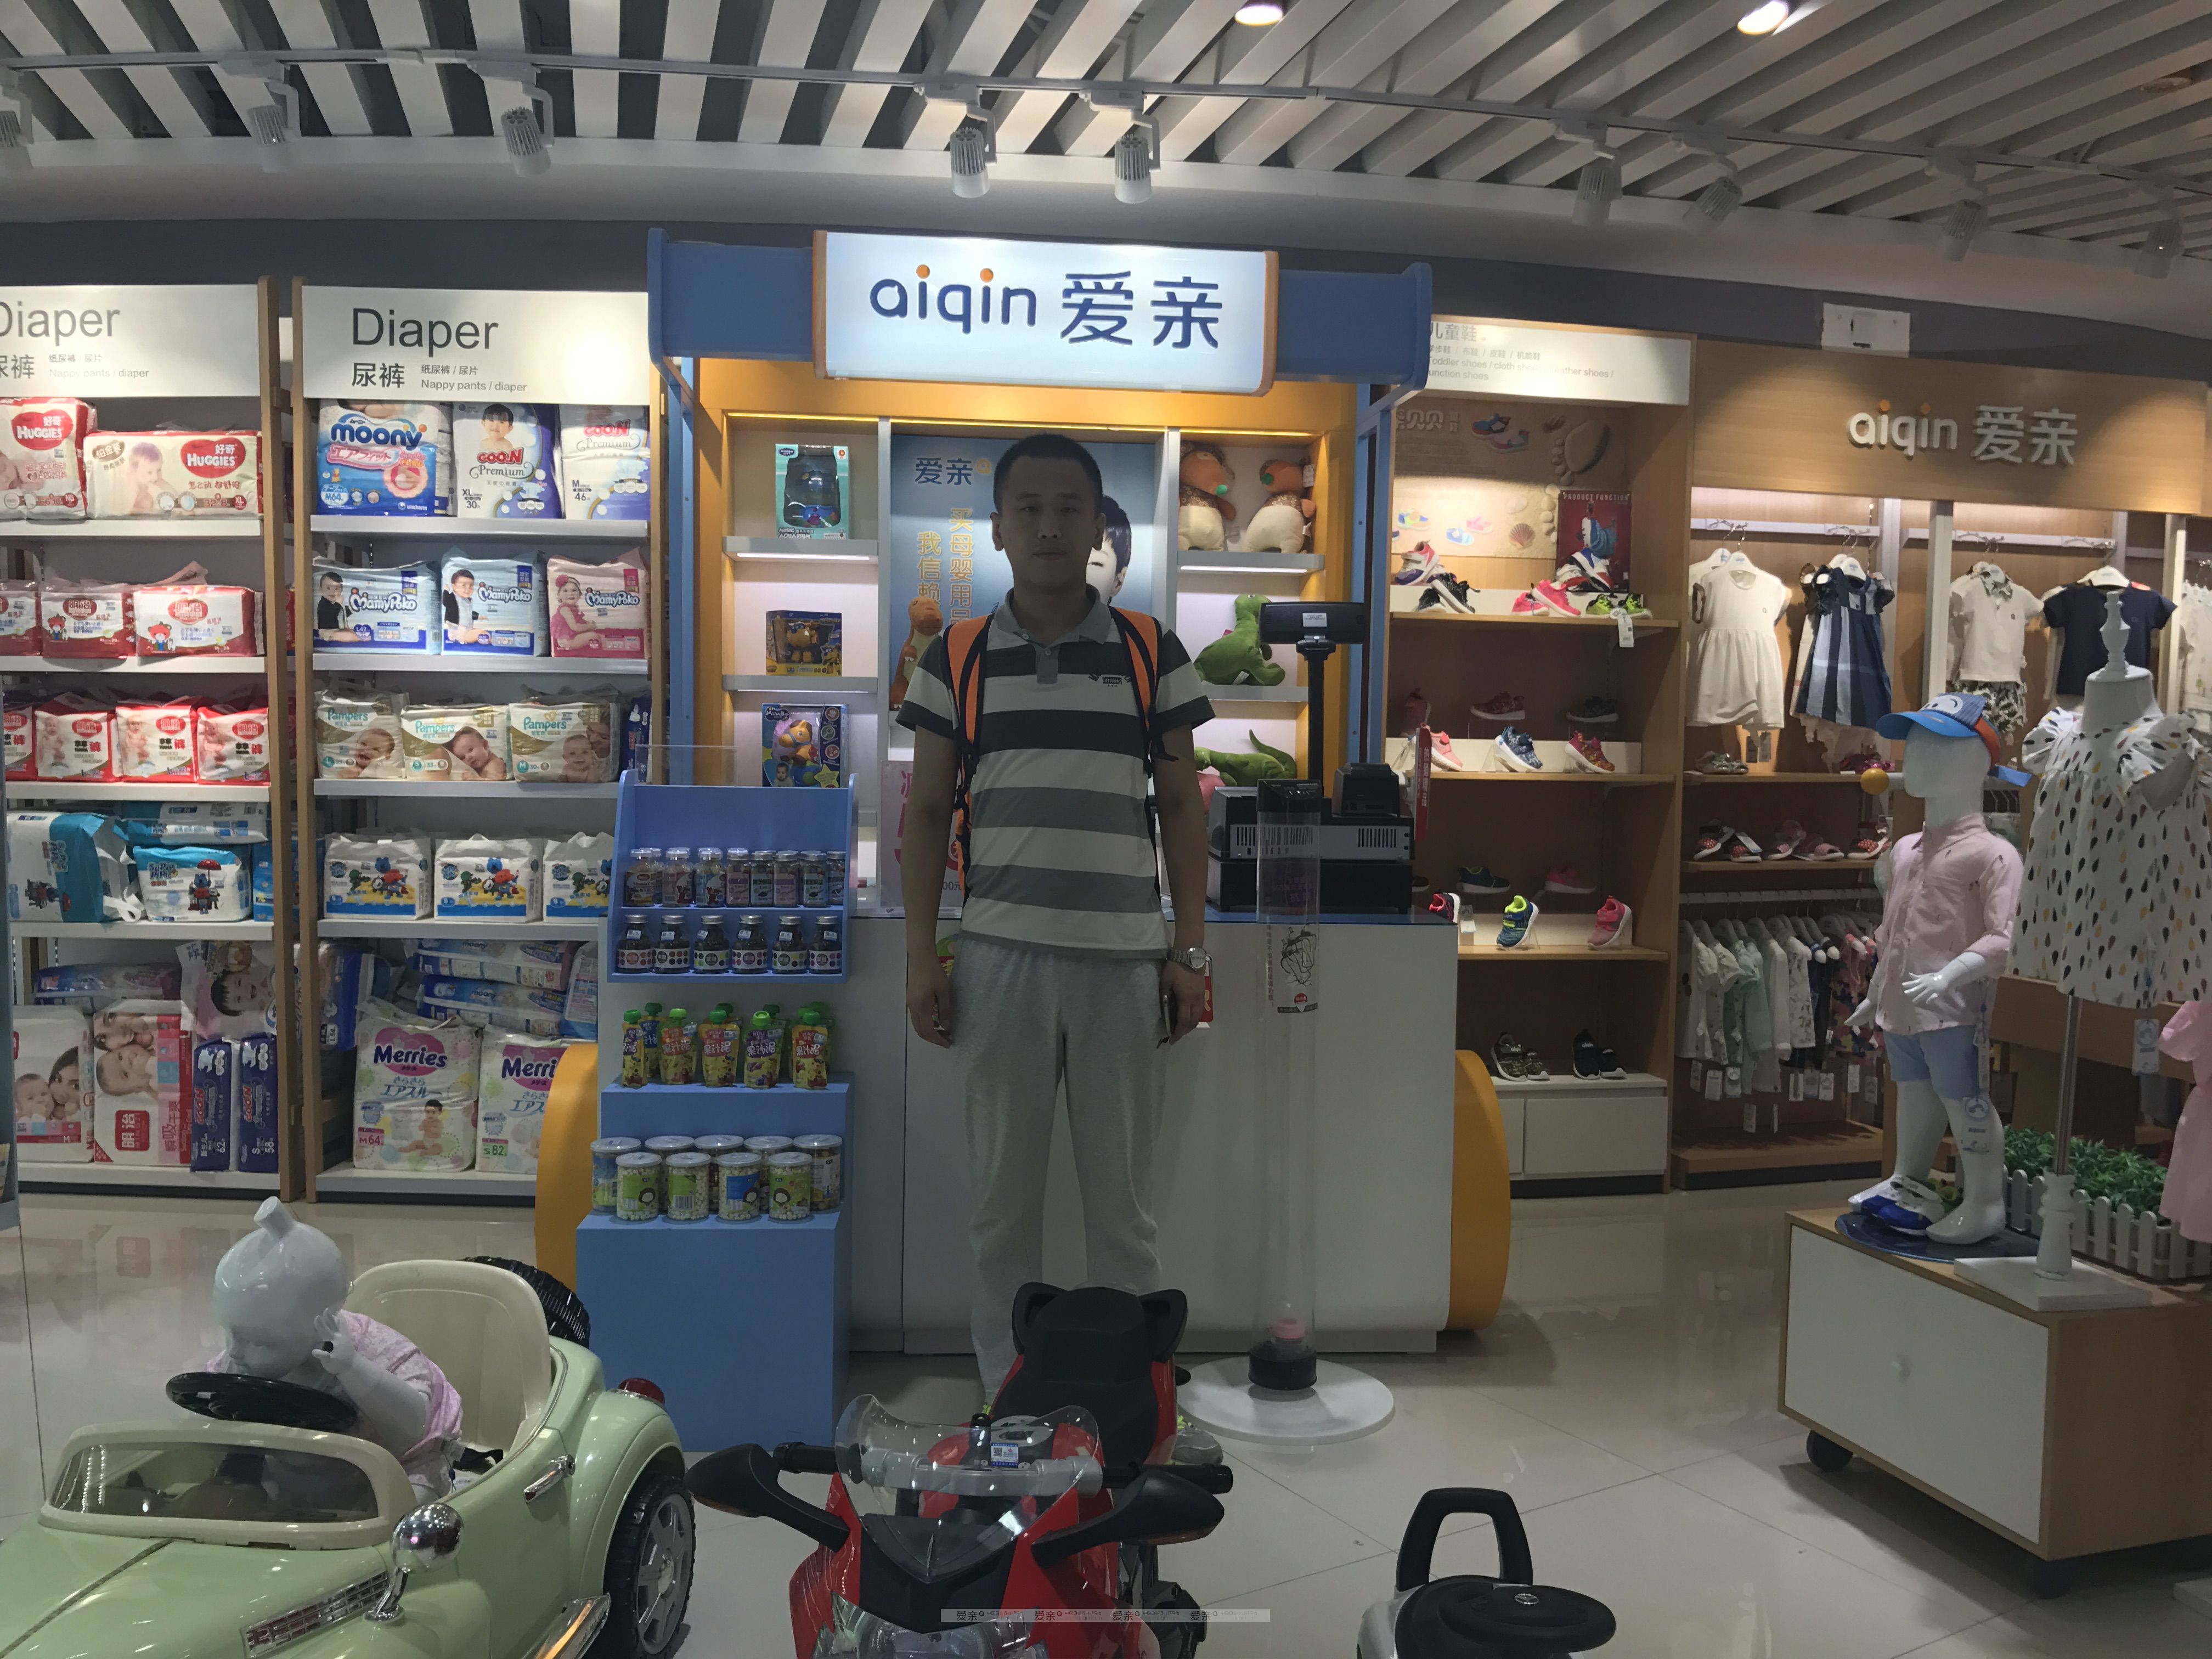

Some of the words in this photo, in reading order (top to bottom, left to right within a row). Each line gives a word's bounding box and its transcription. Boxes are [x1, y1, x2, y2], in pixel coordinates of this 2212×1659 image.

[870, 264, 1036, 335] aiqin
[1060, 271, 1223, 348] 爱亲
[353, 308, 499, 358] Diaper
[49, 354, 76, 363] 纸尿裤
[84, 354, 102, 363] 尿片
[1463, 347, 1478, 356] 布鞋
[1491, 349, 1505, 358] 皮鞋
[0, 354, 35, 379] 裤
[49, 368, 80, 379] Nappy
[83, 368, 110, 379] pants
[119, 368, 149, 379] diaper
[421, 364, 450, 376] 纸尿裤
[459, 365, 478, 376] 尿片
[1462, 359, 1487, 368] shoes
[1494, 362, 1515, 370] cloth
[1584, 369, 1609, 377] shoes
[352, 363, 405, 388] 尿裤
[1429, 369, 1460, 378] unction
[1463, 371, 1488, 380] shoes
[421, 380, 455, 392] Nappy
[457, 381, 488, 392] pants
[495, 382, 527, 392] diaper
[44, 416, 61, 426] 好奇
[16, 426, 63, 439] HUGGIES
[331, 423, 422, 450] moony
[1848, 399, 1957, 460] aiqin
[1973, 405, 2078, 465] 爱亲
[215, 444, 235, 454] 好奇
[187, 454, 235, 466] HUGGIES
[475, 464, 528, 478] Premium
[915, 457, 973, 485] 爱亲
[478, 586, 532, 602] MamyPoko
[585, 590, 640, 607] MamyPoko
[349, 591, 417, 613] MamyPoko
[327, 708, 368, 722] Pampers
[415, 720, 455, 733] Pampers
[523, 716, 567, 731] Pampers
[662, 1040, 691, 1054] 果汁泥
[704, 1041, 731, 1054] 果汁泥
[797, 1043, 820, 1056] 果汁泥
[374, 1045, 448, 1068] Merries
[122, 1113, 135, 1148] 明治
